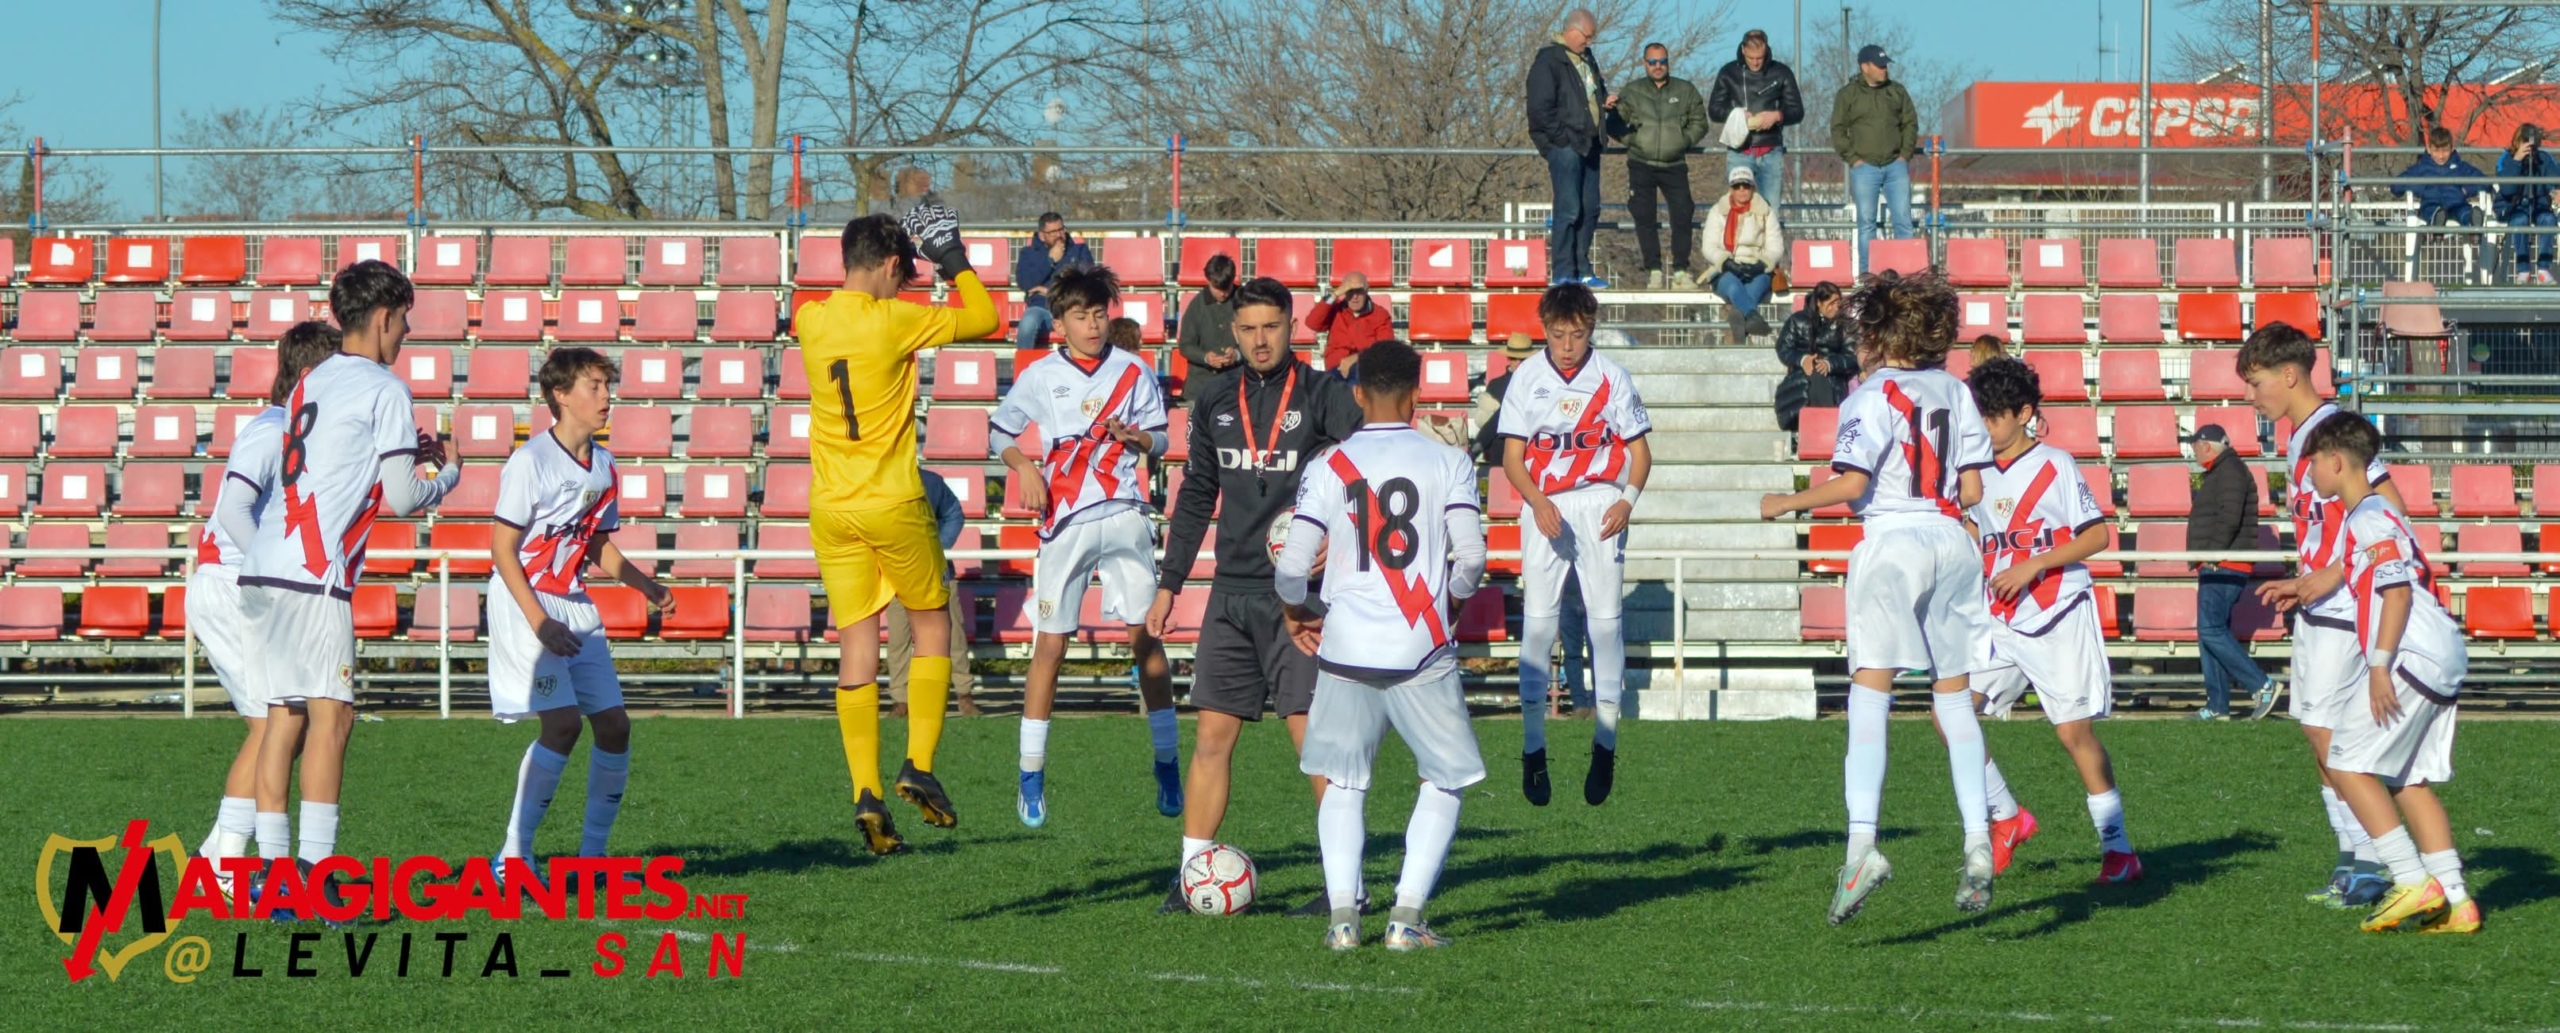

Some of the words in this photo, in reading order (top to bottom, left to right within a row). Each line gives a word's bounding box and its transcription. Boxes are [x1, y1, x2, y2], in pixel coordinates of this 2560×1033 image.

[2089, 97, 2260, 137] CEPSA
[827, 358, 862, 441] 1
[281, 401, 318, 487] 8
[1533, 428, 1613, 450] DIGI
[1906, 406, 1950, 499] 11
[1216, 447, 1298, 472] DIGI
[1343, 476, 1420, 572] 18
[1982, 528, 2054, 554] DIGI
[1202, 896, 1213, 909] 5
